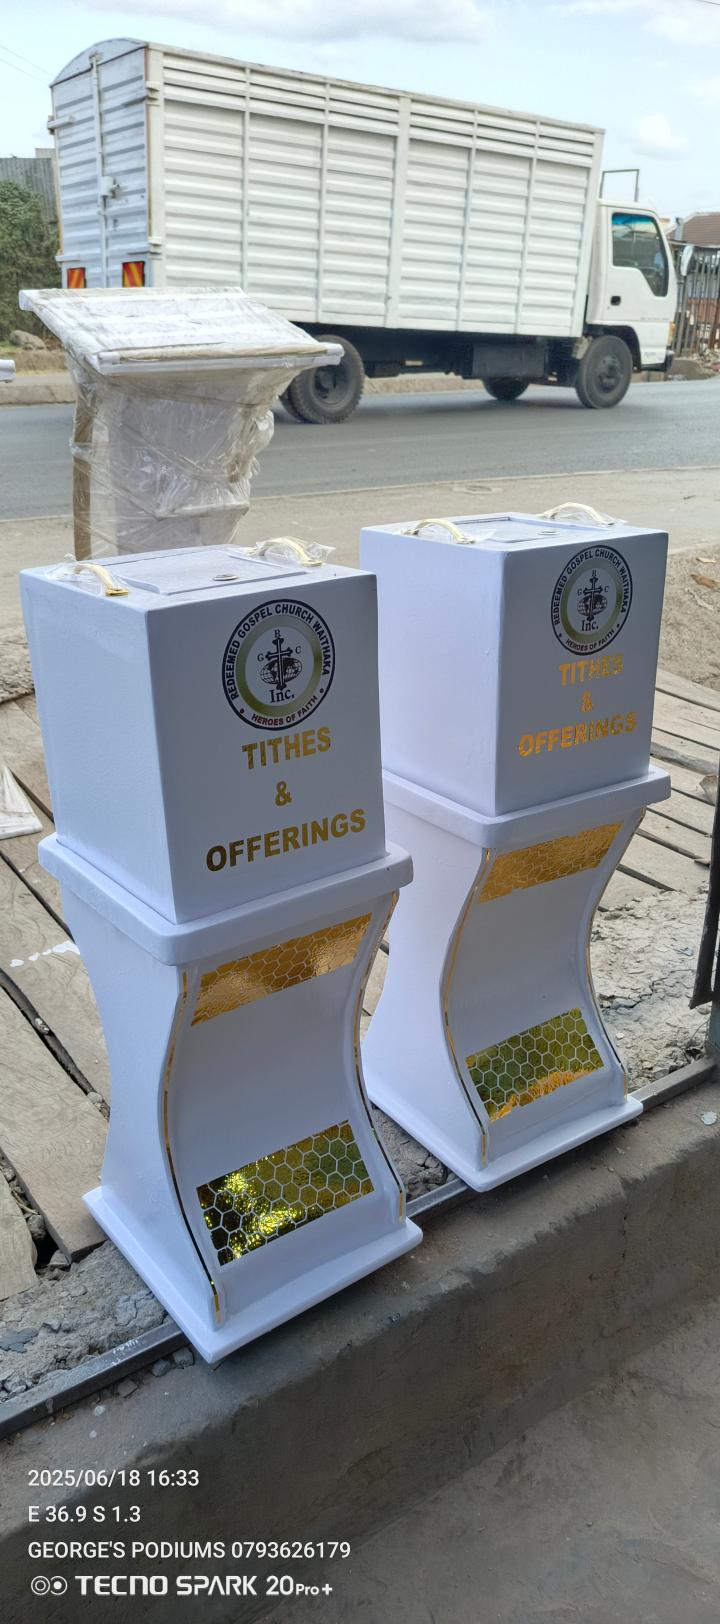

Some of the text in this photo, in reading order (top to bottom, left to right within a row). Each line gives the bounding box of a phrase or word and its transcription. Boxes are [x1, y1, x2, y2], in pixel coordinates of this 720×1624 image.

[553, 549, 630, 625] REDEEMED GOSPEL CHURCH WAITHAKA
[566, 629, 615, 651] HEROES OF FAITH
[581, 619, 599, 632] Inc.
[226, 604, 331, 700] REDEEMED GOSPEL CHURCH WAITHAKA
[257, 646, 302, 662] G C
[559, 652, 624, 686] TITHES
[251, 695, 318, 726] HEROES OF FAITH
[269, 688, 295, 703] Inc.
[242, 726, 331, 770] TITHES
[518, 711, 637, 758] OFFERINGS
[275, 781, 292, 806] &
[206, 808, 366, 872] OFFERINGS
